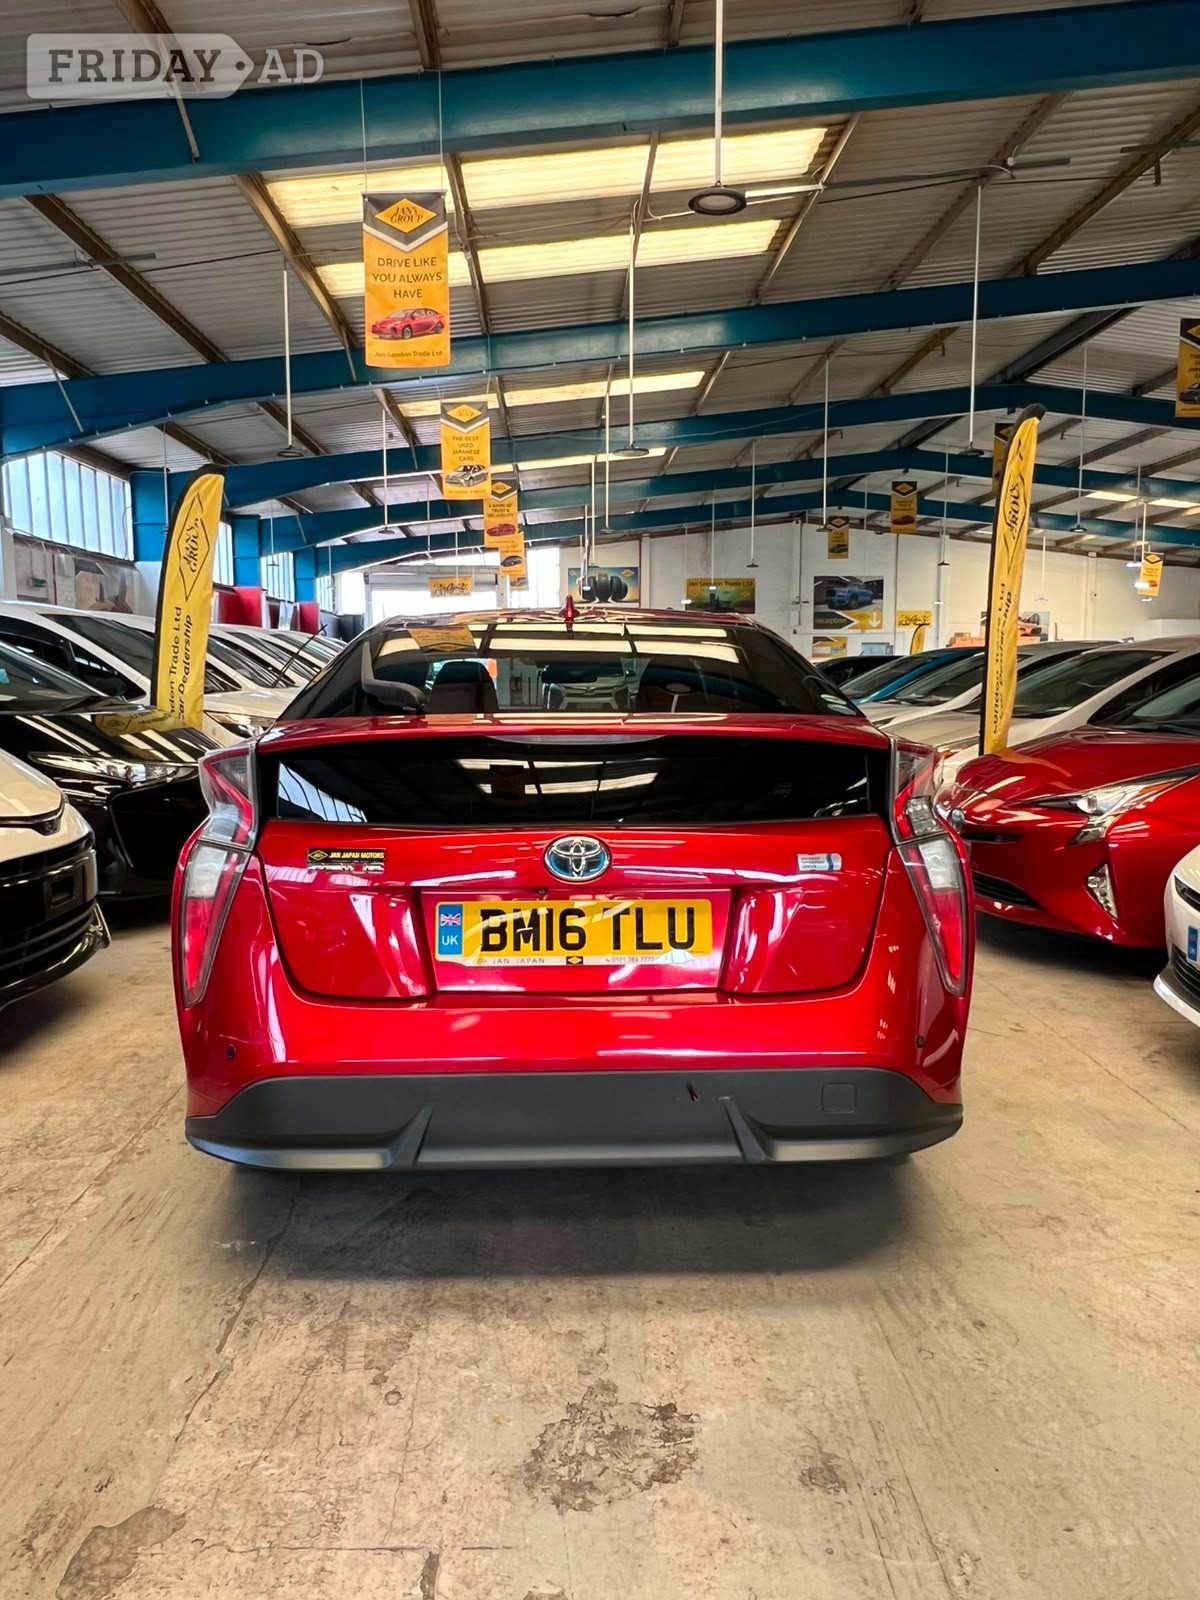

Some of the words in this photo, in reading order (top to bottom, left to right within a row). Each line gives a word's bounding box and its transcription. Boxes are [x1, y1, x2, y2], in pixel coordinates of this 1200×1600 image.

[389, 214, 424, 224] GROUP
[377, 257, 411, 268] DRIVE
[413, 256, 437, 267] LIKE
[372, 272, 396, 283] YOU
[398, 271, 443, 283] ALWAYS
[393, 288, 423, 299] HAVE
[173, 606, 182, 631] Ltd
[168, 635, 180, 676] Trade
[178, 614, 193, 695] Dealership
[360, 851, 385, 859] MOTORS
[480, 908, 586, 952] BM16
[602, 907, 695, 951] TLU
[441, 935, 459, 946] UK
